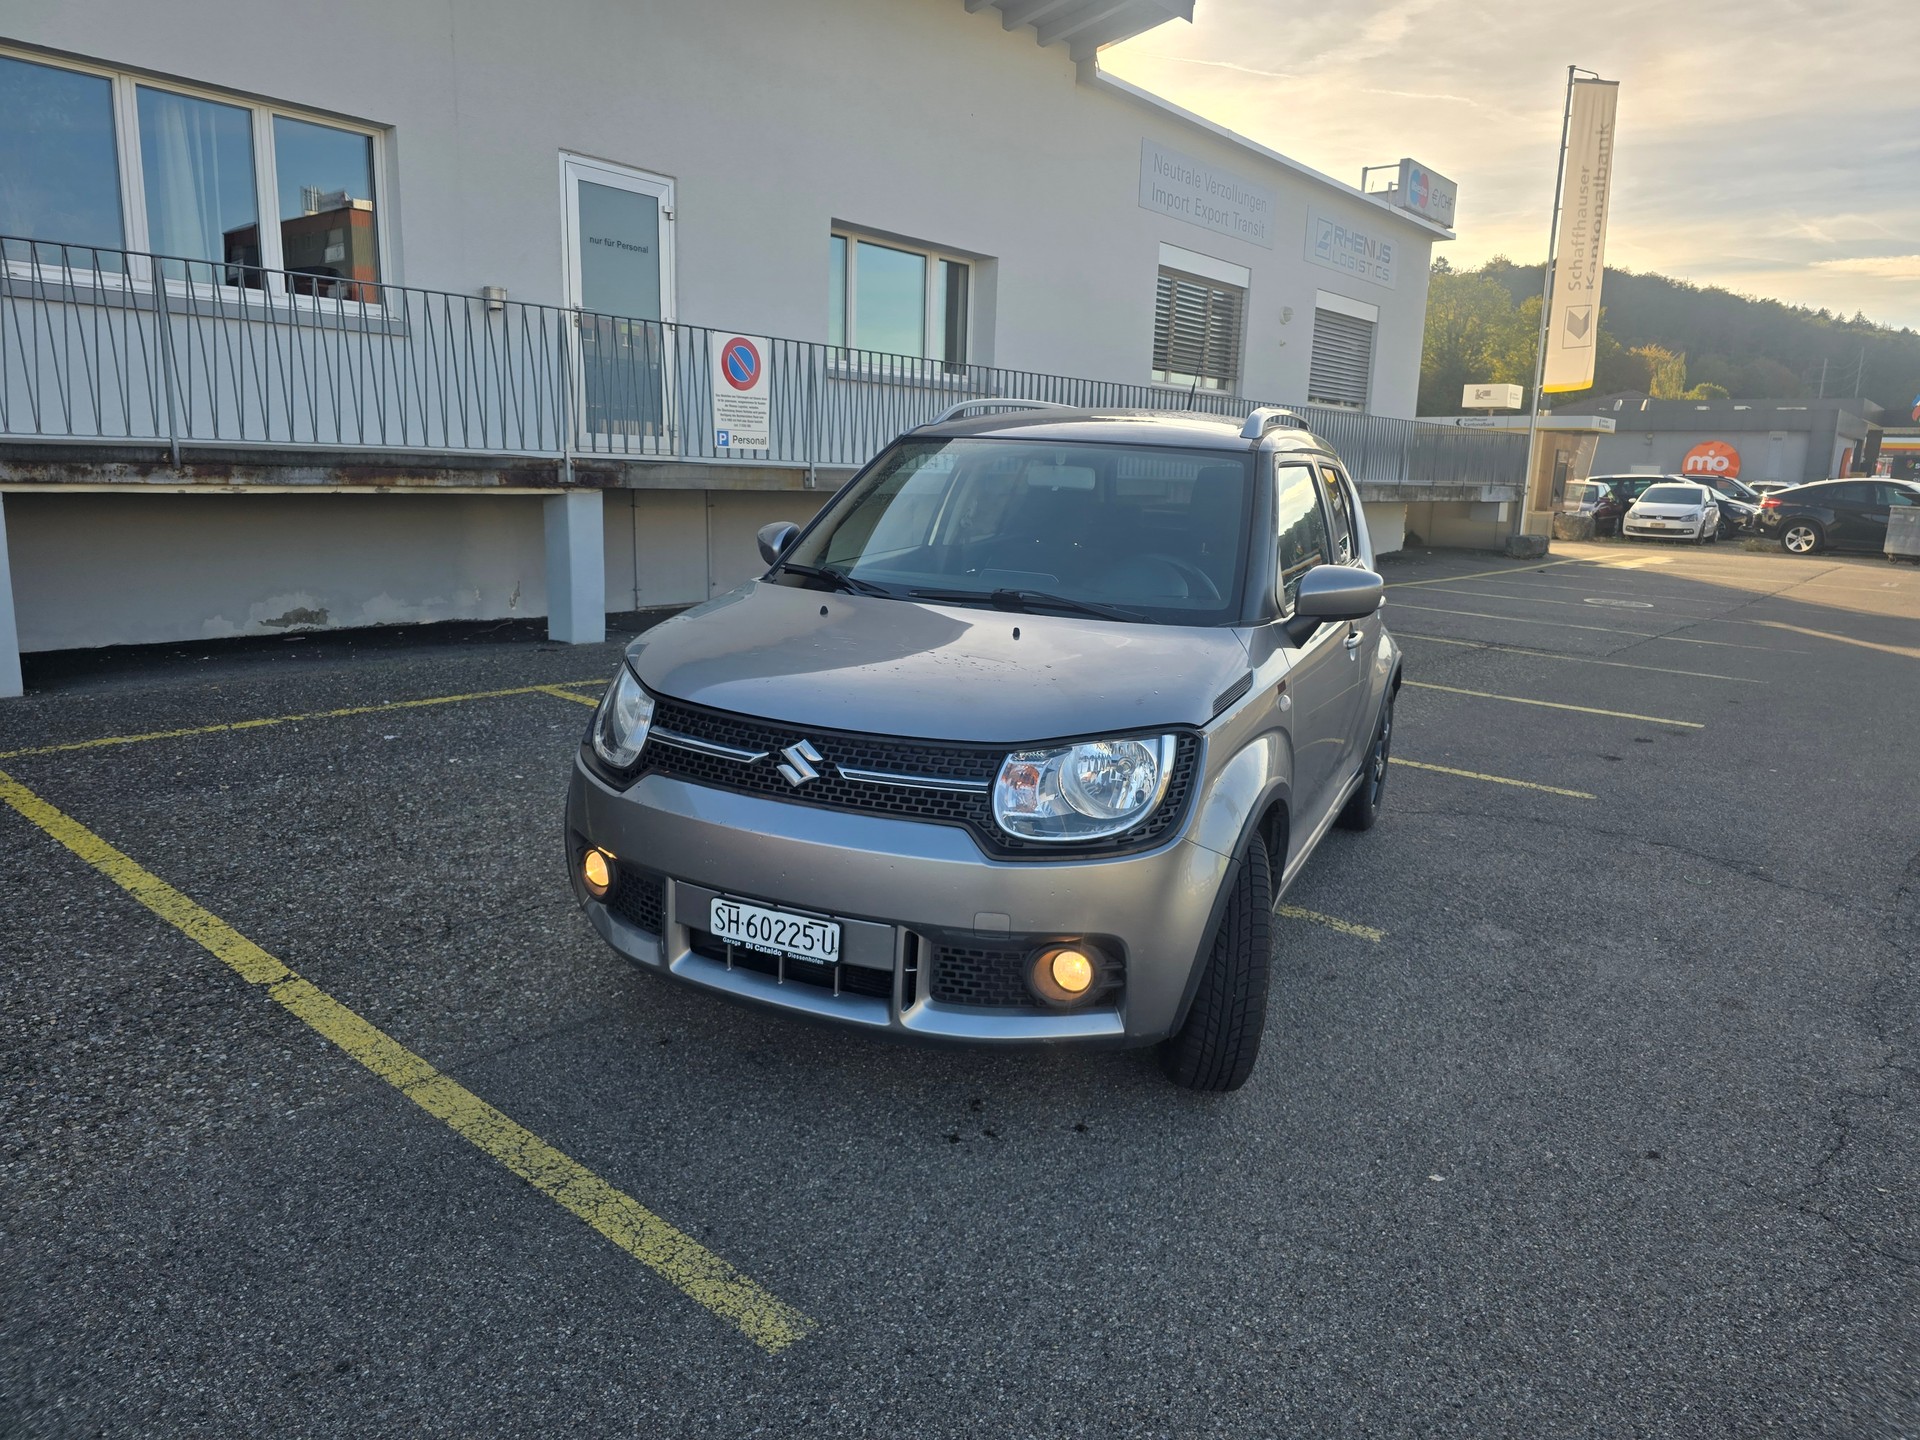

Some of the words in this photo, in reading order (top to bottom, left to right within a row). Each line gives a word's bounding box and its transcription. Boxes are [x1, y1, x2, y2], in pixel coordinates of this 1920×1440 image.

[1153, 152, 1201, 189] Neutrale
[1204, 175, 1267, 214] Verzollungen
[1151, 182, 1190, 215] Import
[1194, 197, 1229, 229] Export
[1233, 210, 1265, 239] Transit
[1585, 122, 1610, 290] Kantonalbank
[589, 236, 602, 245] nur
[604, 237, 615, 247] für
[616, 240, 649, 254] Personal
[1333, 225, 1391, 264] RHENUS
[1567, 165, 1590, 291] Schaffhauser
[1332, 250, 1390, 282] LOGISTICS
[732, 434, 767, 447] Personal
[1686, 449, 1730, 472] mio
[722, 936, 742, 947] Garage
[745, 942, 754, 950] Di
[754, 944, 783, 957] Cataldo
